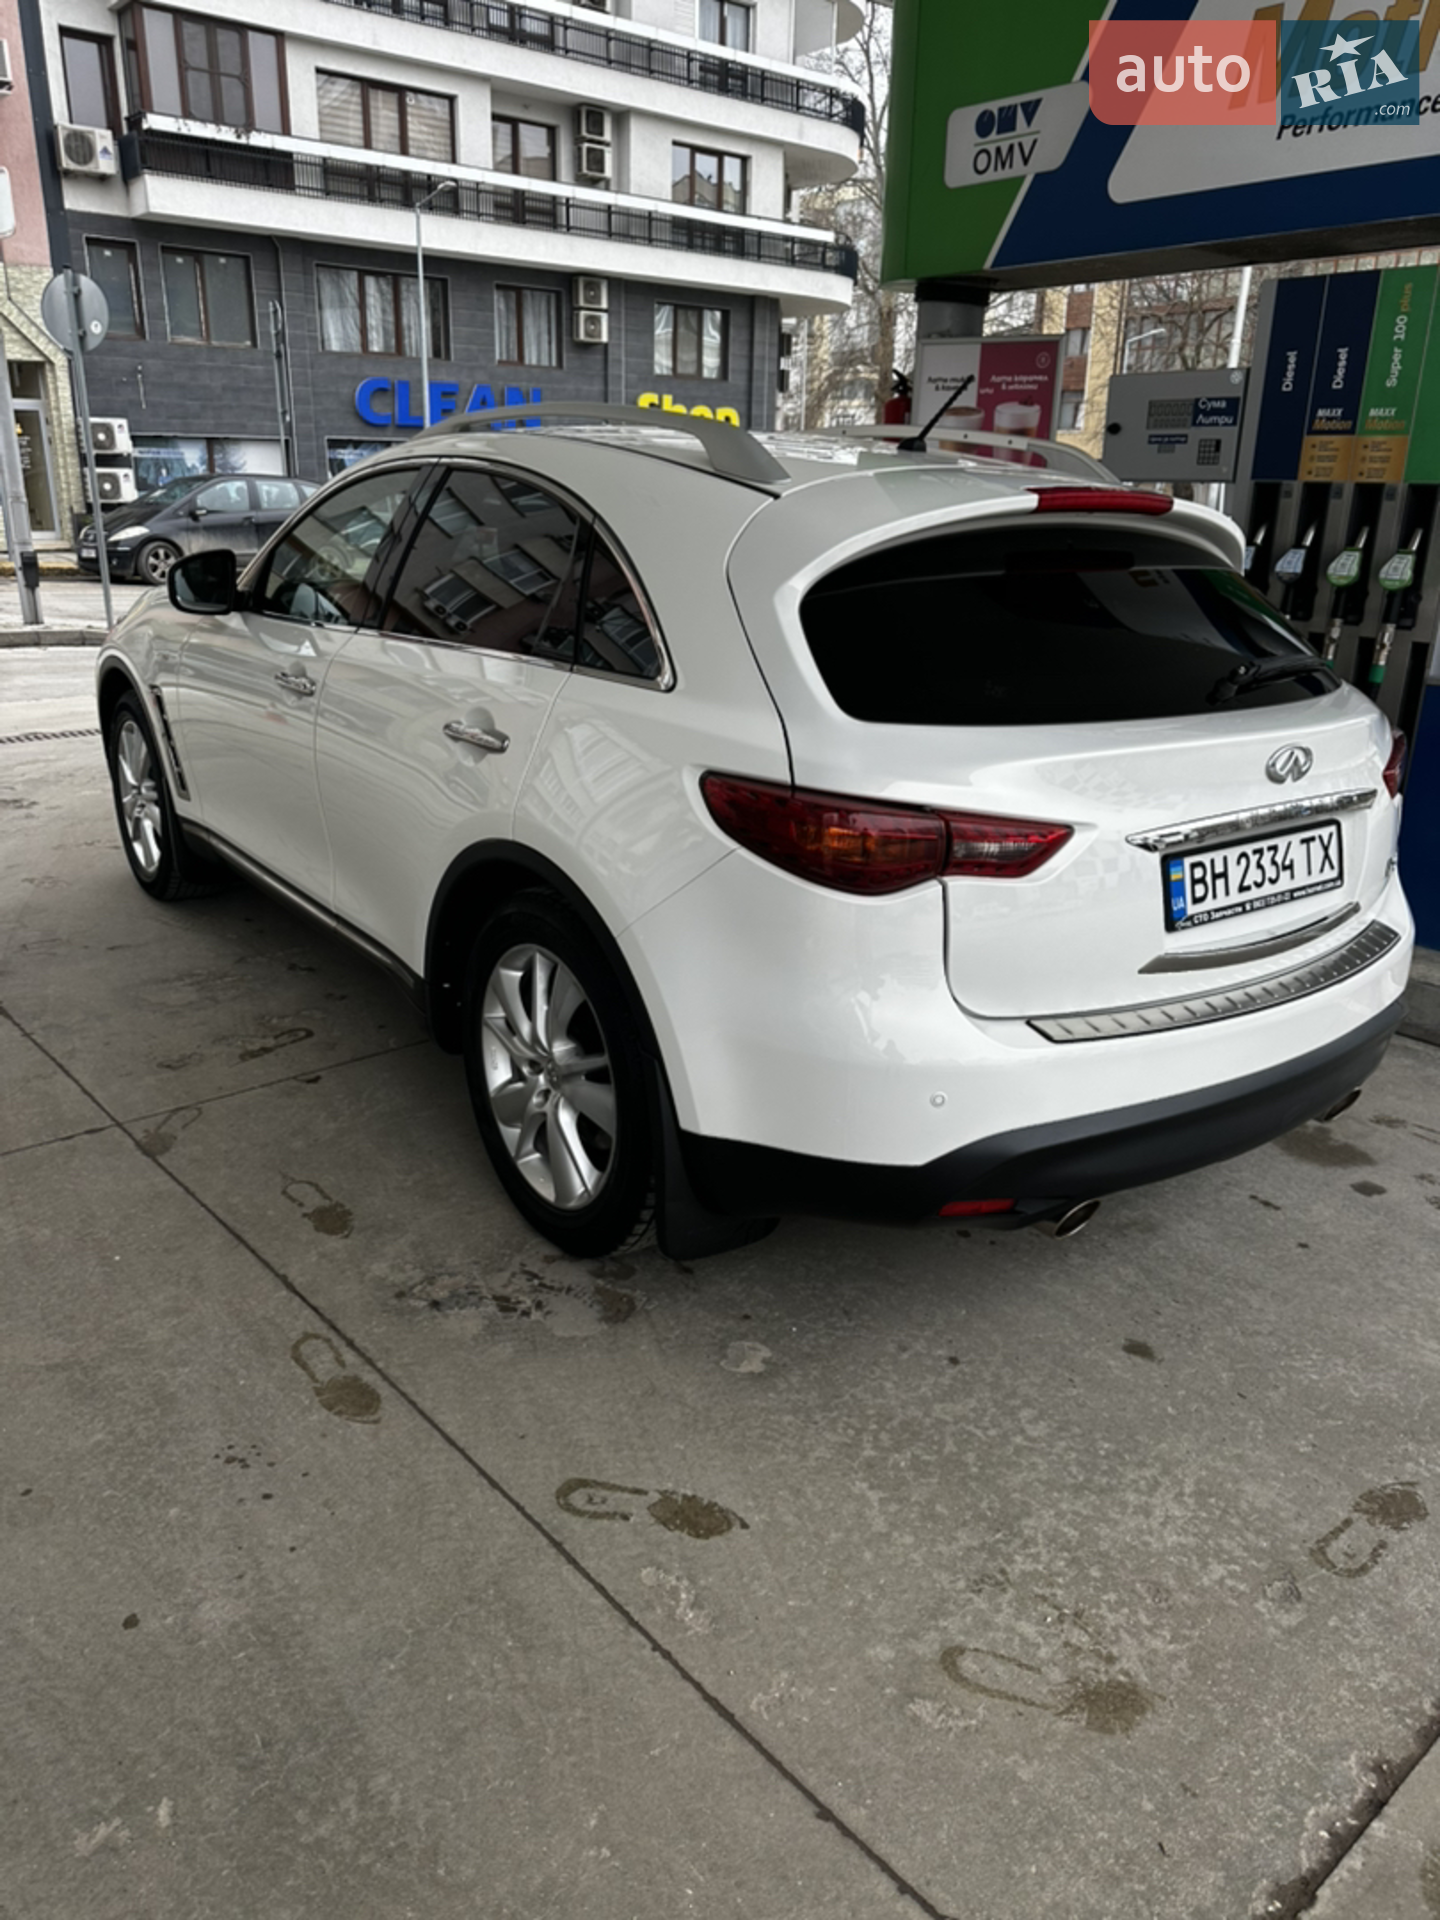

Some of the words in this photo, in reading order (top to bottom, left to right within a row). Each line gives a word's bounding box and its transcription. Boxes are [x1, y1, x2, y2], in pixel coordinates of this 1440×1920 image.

[973, 138, 1038, 175] OMV
[1393, 315, 1408, 341] 100
[1281, 350, 1298, 392] Diesel
[1332, 347, 1349, 389] Diesel
[1386, 347, 1403, 388] Super
[355, 376, 542, 429] CLEAN
[1198, 397, 1227, 411] Сума
[1189, 855, 1230, 906] BH
[1236, 840, 1295, 894] 2334
[1300, 831, 1335, 877] TX
[1172, 896, 1185, 911] UA
